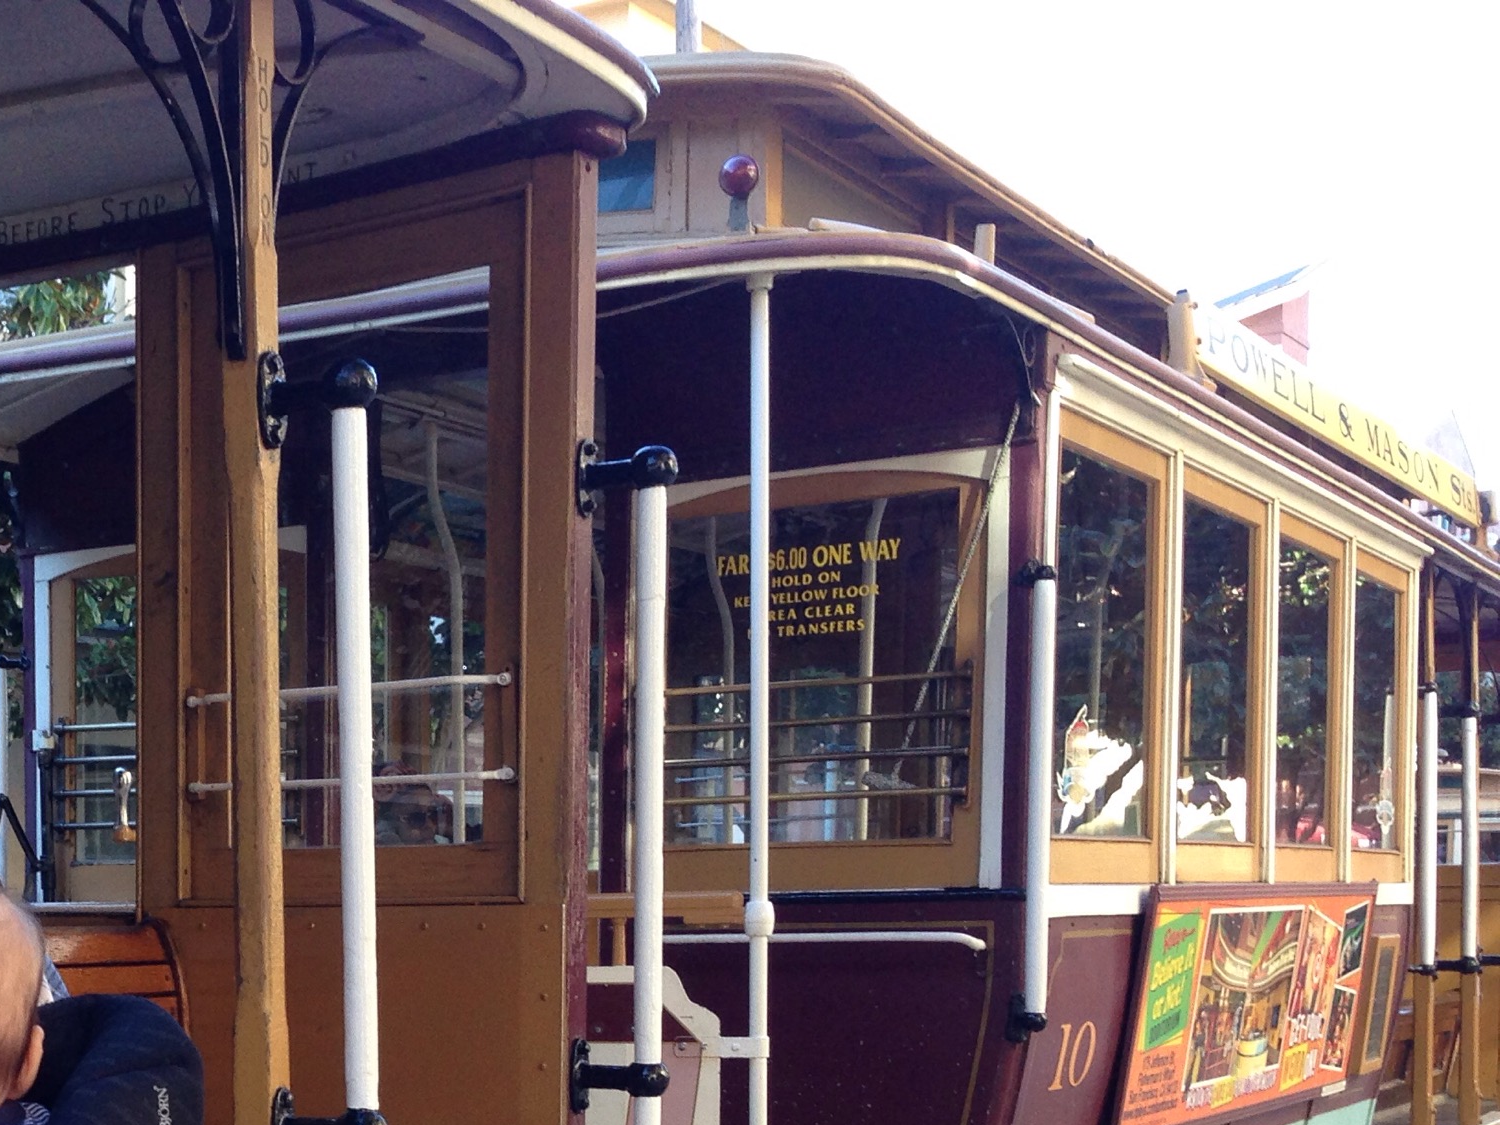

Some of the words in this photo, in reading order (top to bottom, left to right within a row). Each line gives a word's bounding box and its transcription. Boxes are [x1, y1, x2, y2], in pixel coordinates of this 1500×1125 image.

[257, 57, 270, 169] HOLD
[102, 196, 165, 225] STOP
[261, 193, 272, 247] ON
[1207, 316, 1327, 425] POWELL
[1338, 402, 1355, 443] &
[1364, 418, 1441, 494] MASON
[717, 554, 751, 577] FAR
[812, 542, 853, 568] ONE
[859, 537, 901, 563] WAY
[771, 573, 813, 588] HOLD
[818, 570, 841, 584] ON
[771, 588, 828, 605] YELLOW
[832, 583, 880, 599] FLOOR
[768, 608, 798, 622] REA
[804, 602, 856, 621] CLEAR
[777, 617, 866, 638] TRANSFERS
[1047, 1020, 1098, 1092] 10
